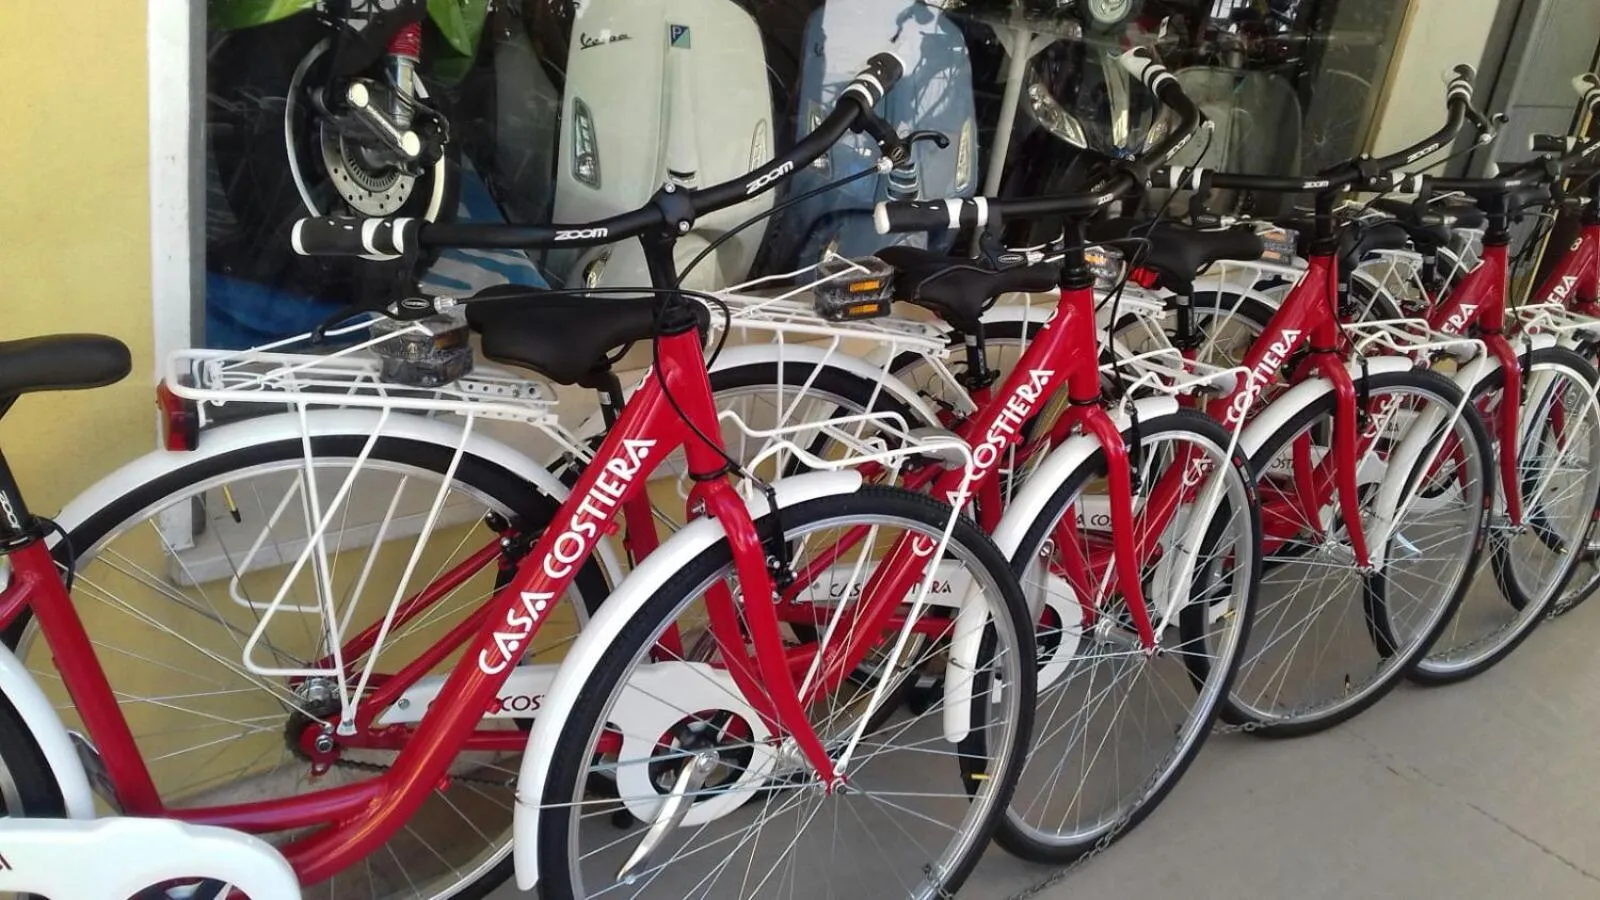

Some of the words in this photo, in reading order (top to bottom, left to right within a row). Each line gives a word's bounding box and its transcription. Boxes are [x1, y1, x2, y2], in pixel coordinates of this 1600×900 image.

[968, 369, 1053, 481] COSTIERA
[479, 591, 555, 675] CASA
[543, 439, 657, 579] COSTIERA
